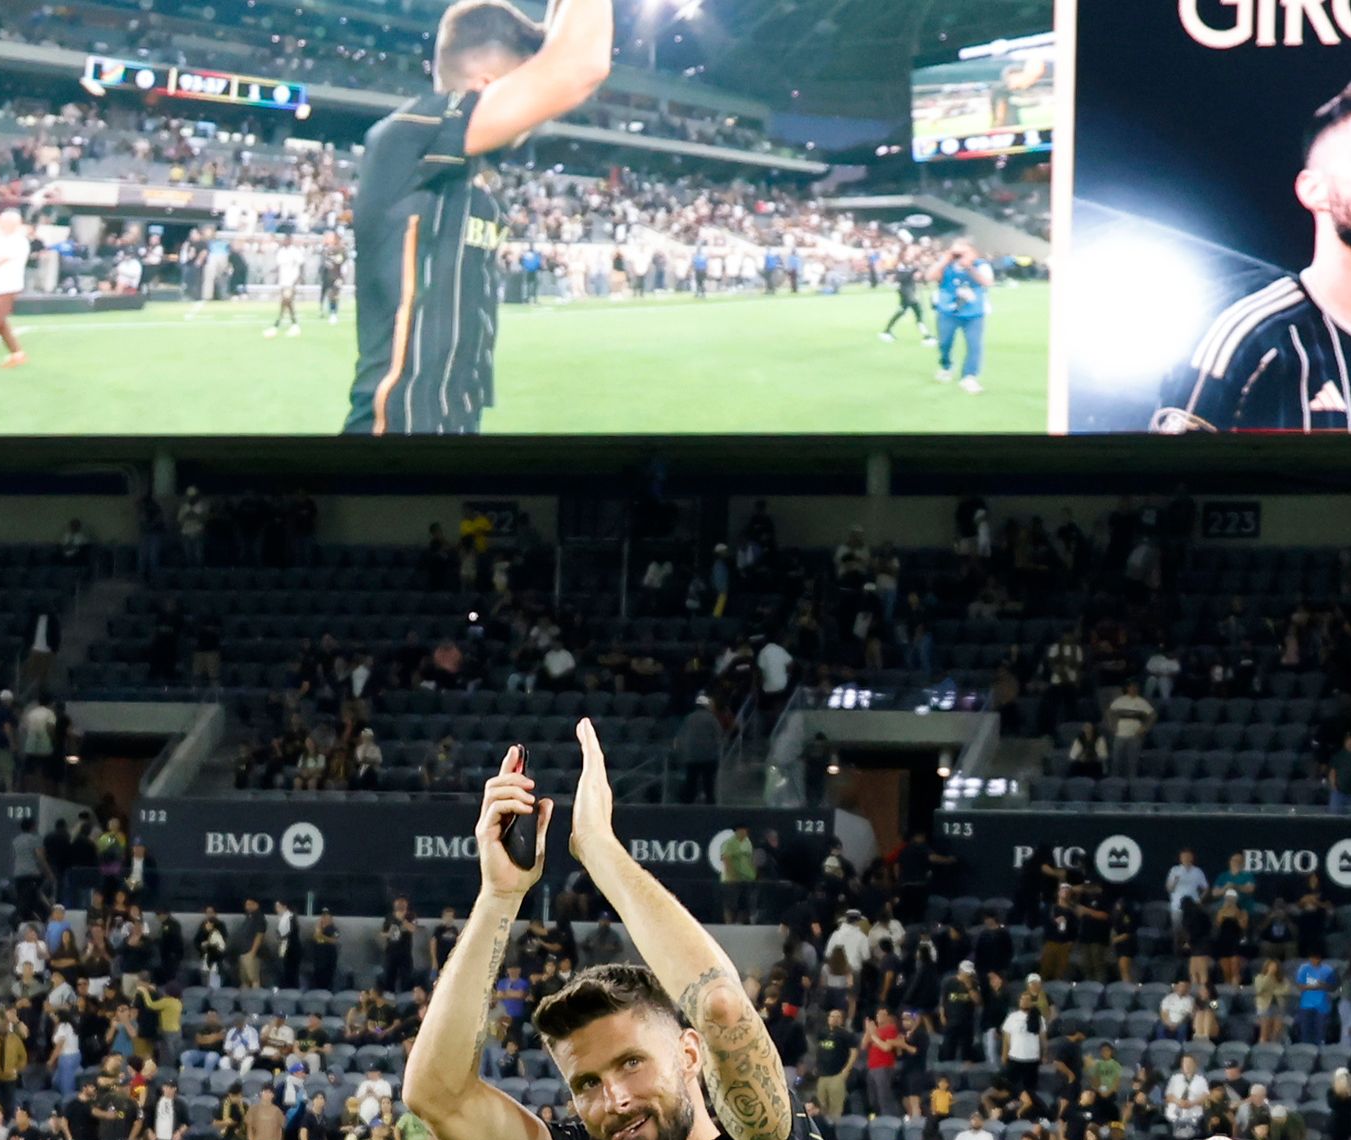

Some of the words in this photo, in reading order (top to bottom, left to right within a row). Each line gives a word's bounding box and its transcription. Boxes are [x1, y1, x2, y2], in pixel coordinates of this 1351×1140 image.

[1208, 510, 1256, 532] 223
[795, 819, 825, 833] 122
[943, 821, 974, 838] 123
[205, 831, 274, 856] BMO
[414, 835, 480, 859] BMO
[631, 838, 700, 864] BMO
[1243, 848, 1318, 874] BMO
